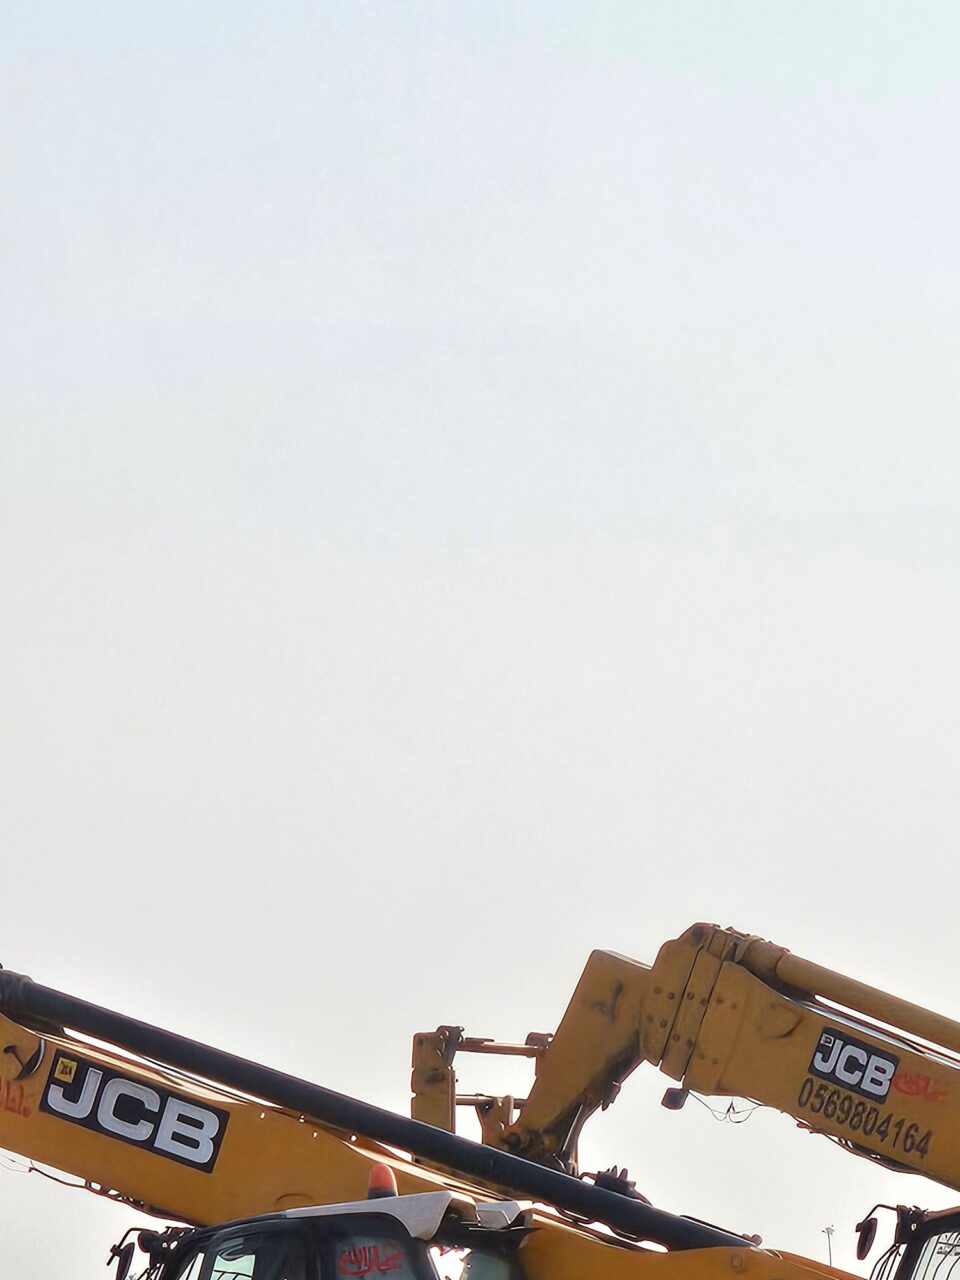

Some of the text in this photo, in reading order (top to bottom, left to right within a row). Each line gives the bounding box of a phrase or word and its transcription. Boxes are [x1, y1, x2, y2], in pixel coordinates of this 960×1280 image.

[813, 1039, 895, 1096] JCB
[47, 1067, 220, 1164] JCB
[797, 1076, 932, 1159] 0569804164
